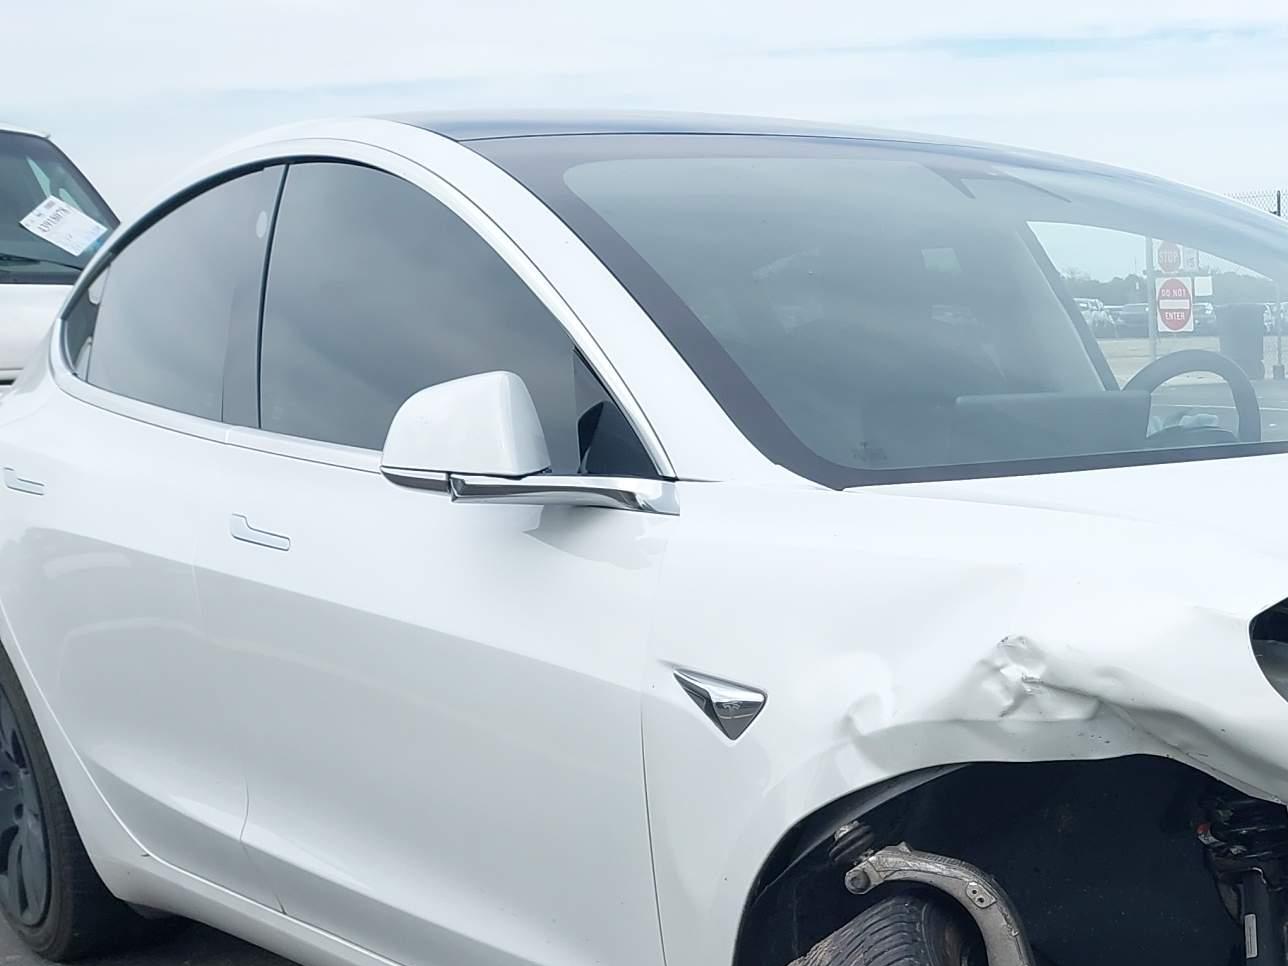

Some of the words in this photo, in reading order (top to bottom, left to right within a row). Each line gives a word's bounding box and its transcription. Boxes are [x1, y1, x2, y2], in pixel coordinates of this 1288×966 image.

[1161, 288, 1171, 297] DO
[1172, 287, 1186, 297] NOT
[1165, 311, 1186, 321] ENTER
